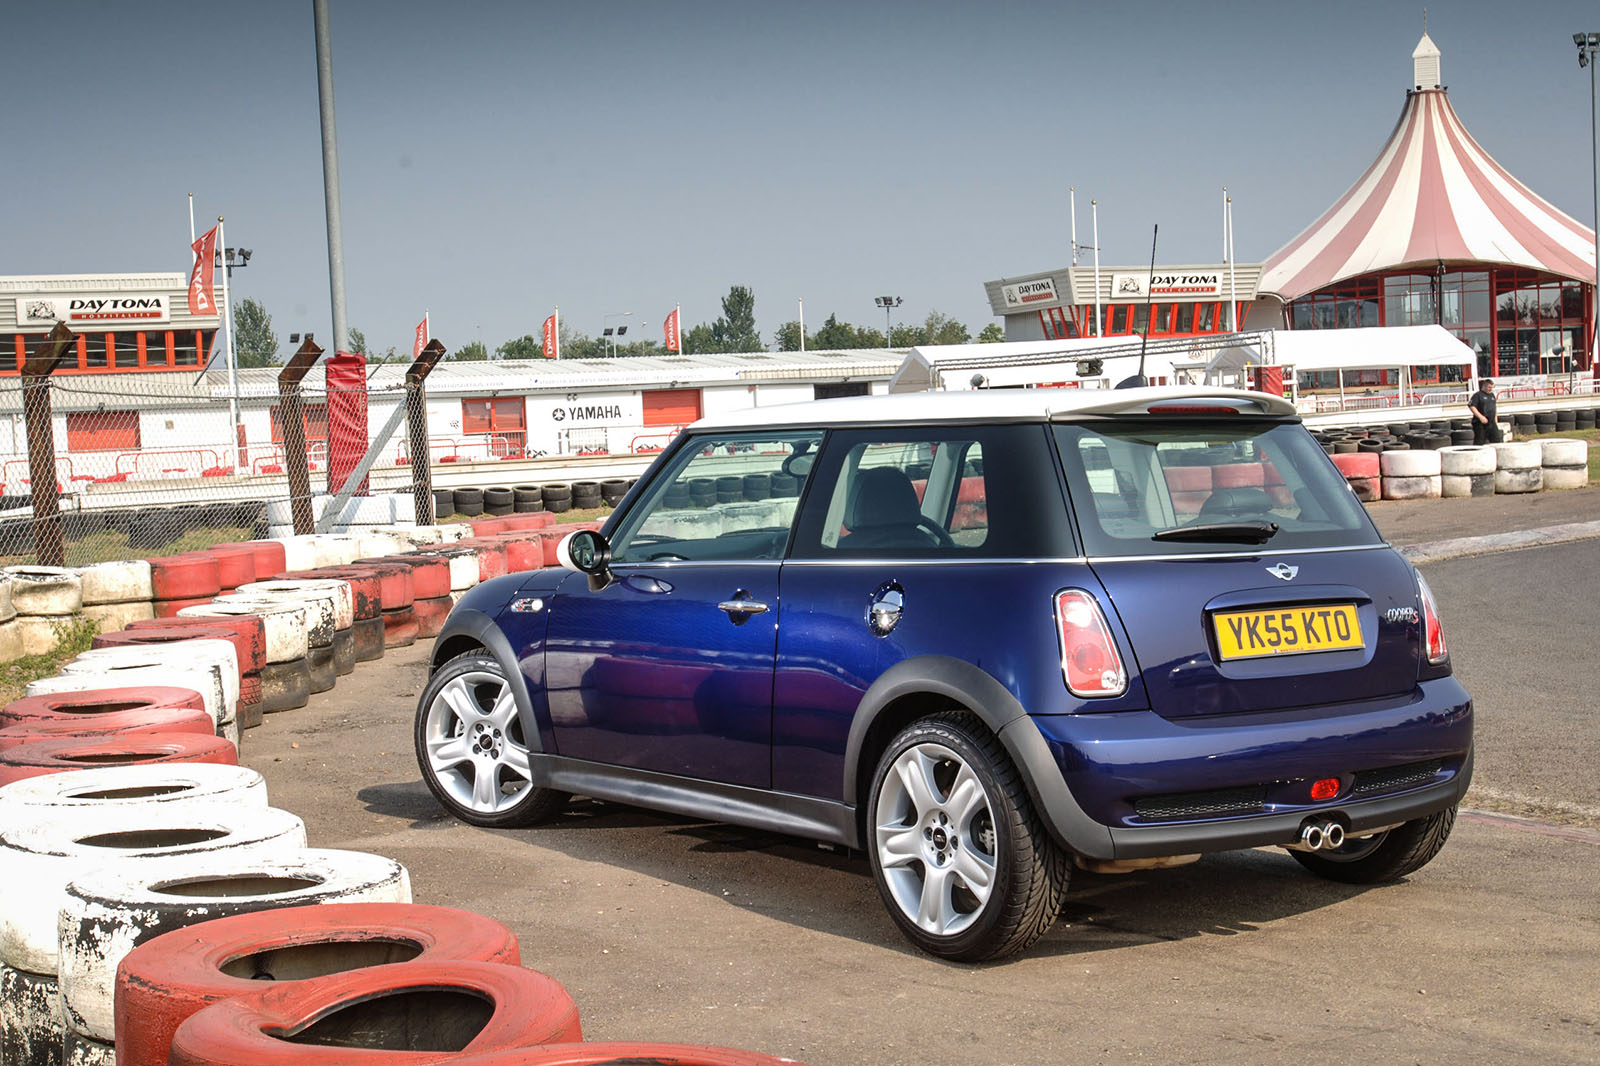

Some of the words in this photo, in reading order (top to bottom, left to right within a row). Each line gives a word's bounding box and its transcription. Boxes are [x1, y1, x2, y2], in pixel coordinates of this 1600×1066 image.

[1018, 281, 1051, 296] DAYTONA
[1151, 275, 1217, 287] DAYTONA
[69, 298, 162, 313] DAYTONA
[569, 405, 622, 420] YAMAHA
[1227, 613, 1298, 650] YK55
[1302, 610, 1351, 644] KTO
